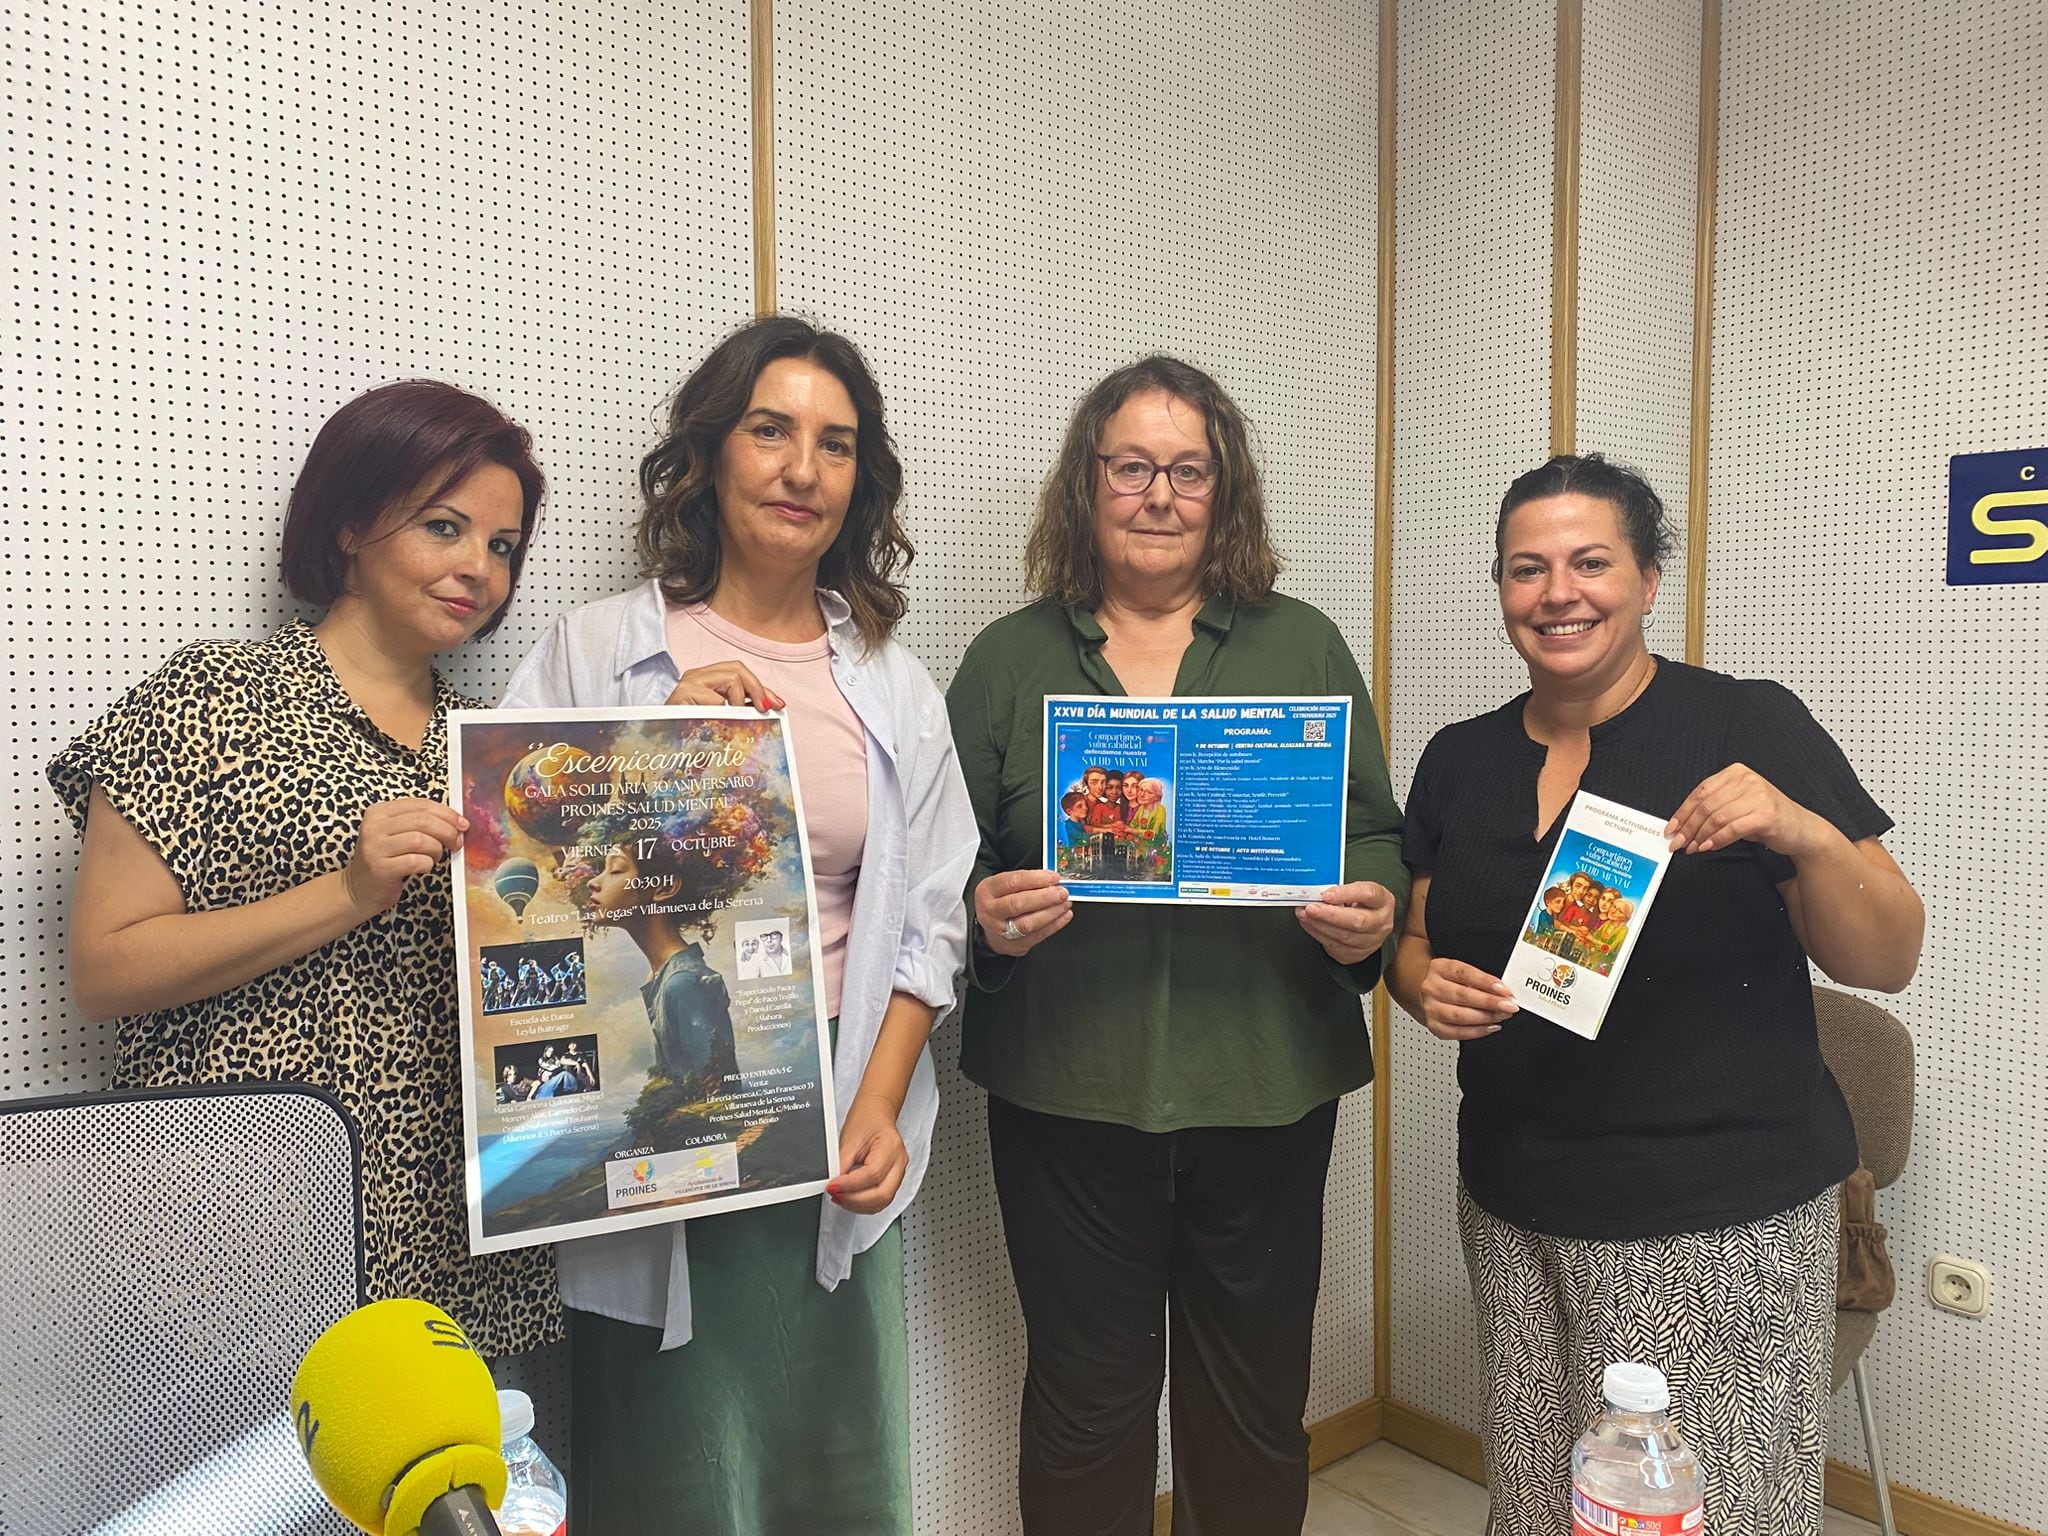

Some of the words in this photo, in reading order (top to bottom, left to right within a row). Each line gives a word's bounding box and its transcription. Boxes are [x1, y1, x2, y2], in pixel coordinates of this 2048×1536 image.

[1054, 706, 1084, 718] XXVII
[1087, 704, 1106, 718] DÍA
[1110, 707, 1159, 719] MUNDIAL
[1162, 709, 1178, 719] DE
[1181, 708, 1197, 719] LA
[1200, 708, 1237, 719] SALUD
[1240, 707, 1286, 719] MENTAL
[1224, 727, 1272, 736] PROGRAMA:
[1083, 748, 1121, 756] defendamos
[1081, 756, 1110, 766] SALUD
[1114, 756, 1148, 767] MENTAL
[525, 784, 567, 799] GALA
[568, 781, 649, 798] SOLIDARIA
[668, 775, 755, 793] ANIVERSARIO
[561, 801, 624, 817] PROINES
[627, 800, 675, 815] SALUD
[677, 796, 733, 812] MENTAL
[629, 817, 662, 831] 2025
[1585, 804, 1619, 821] PROGRAMA
[1619, 817, 1661, 837] ACTIVIDADES
[1604, 820, 1634, 835] OCTUBRE
[561, 843, 621, 859] VIERNES
[635, 837, 658, 861] 17
[671, 835, 736, 853] OCTUBRE
[623, 875, 661, 890] 20:30
[662, 874, 674, 887] H
[529, 912, 569, 926] Teatro
[640, 902, 696, 915] Villanueva
[698, 899, 712, 911] de
[714, 897, 724, 909] la
[726, 896, 764, 909] Serena
[1525, 977, 1571, 1005] PROINES
[510, 1016, 539, 1026] Escuela
[540, 1014, 550, 1023] de
[551, 1013, 574, 1022] Danza
[517, 1026, 536, 1037] Leyla
[537, 1023, 569, 1034] Buitrago
[723, 1071, 749, 1082] PRECIO
[706, 1094, 732, 1104] Librería
[775, 1084, 806, 1094] Francisco
[725, 1101, 757, 1111] Villanueva
[772, 1094, 795, 1103] Serena
[733, 1110, 752, 1120] Salud
[743, 1119, 758, 1127] Don
[758, 1116, 779, 1125] Benito
[685, 1132, 728, 1146] COLABORA
[614, 1146, 655, 1159] ORGANIZA
[615, 1183, 657, 1198] PROINES
